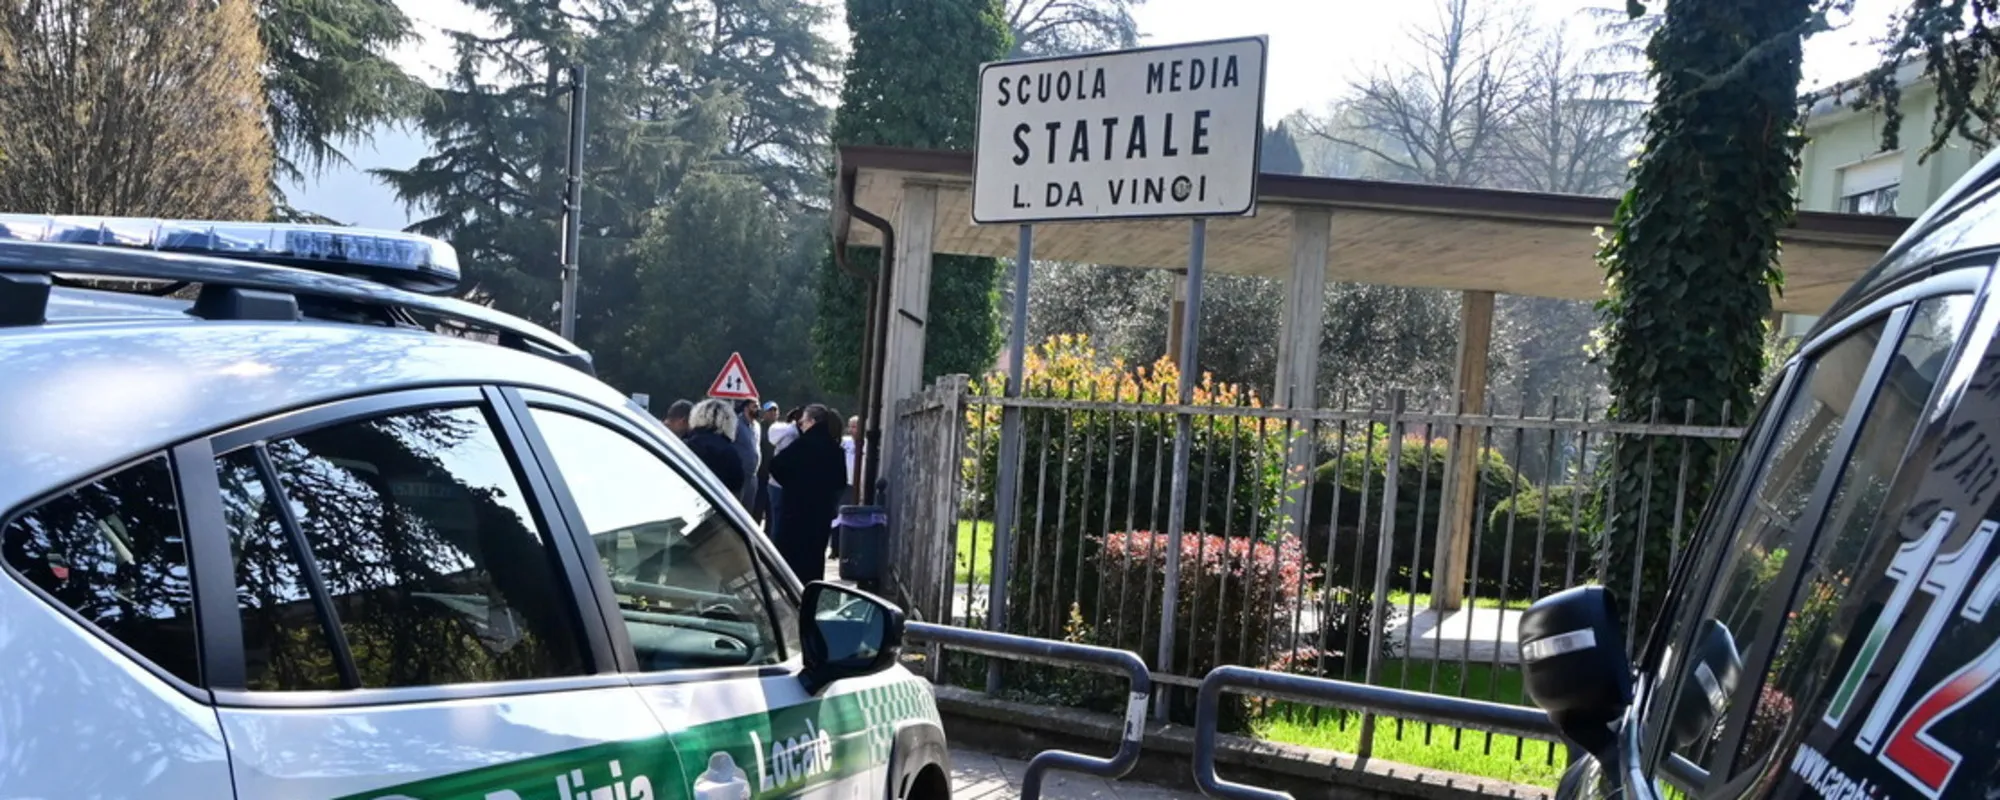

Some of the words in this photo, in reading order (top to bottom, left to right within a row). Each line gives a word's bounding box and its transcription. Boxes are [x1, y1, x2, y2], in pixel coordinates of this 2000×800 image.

[997, 67, 1106, 107] SCUOLA
[1146, 54, 1239, 95] MEDIA
[1012, 109, 1211, 166] STATALE
[1012, 183, 1031, 209] L.
[1045, 181, 1084, 208] DA
[1107, 175, 1207, 206] VINCI
[749, 717, 833, 793] Locale
